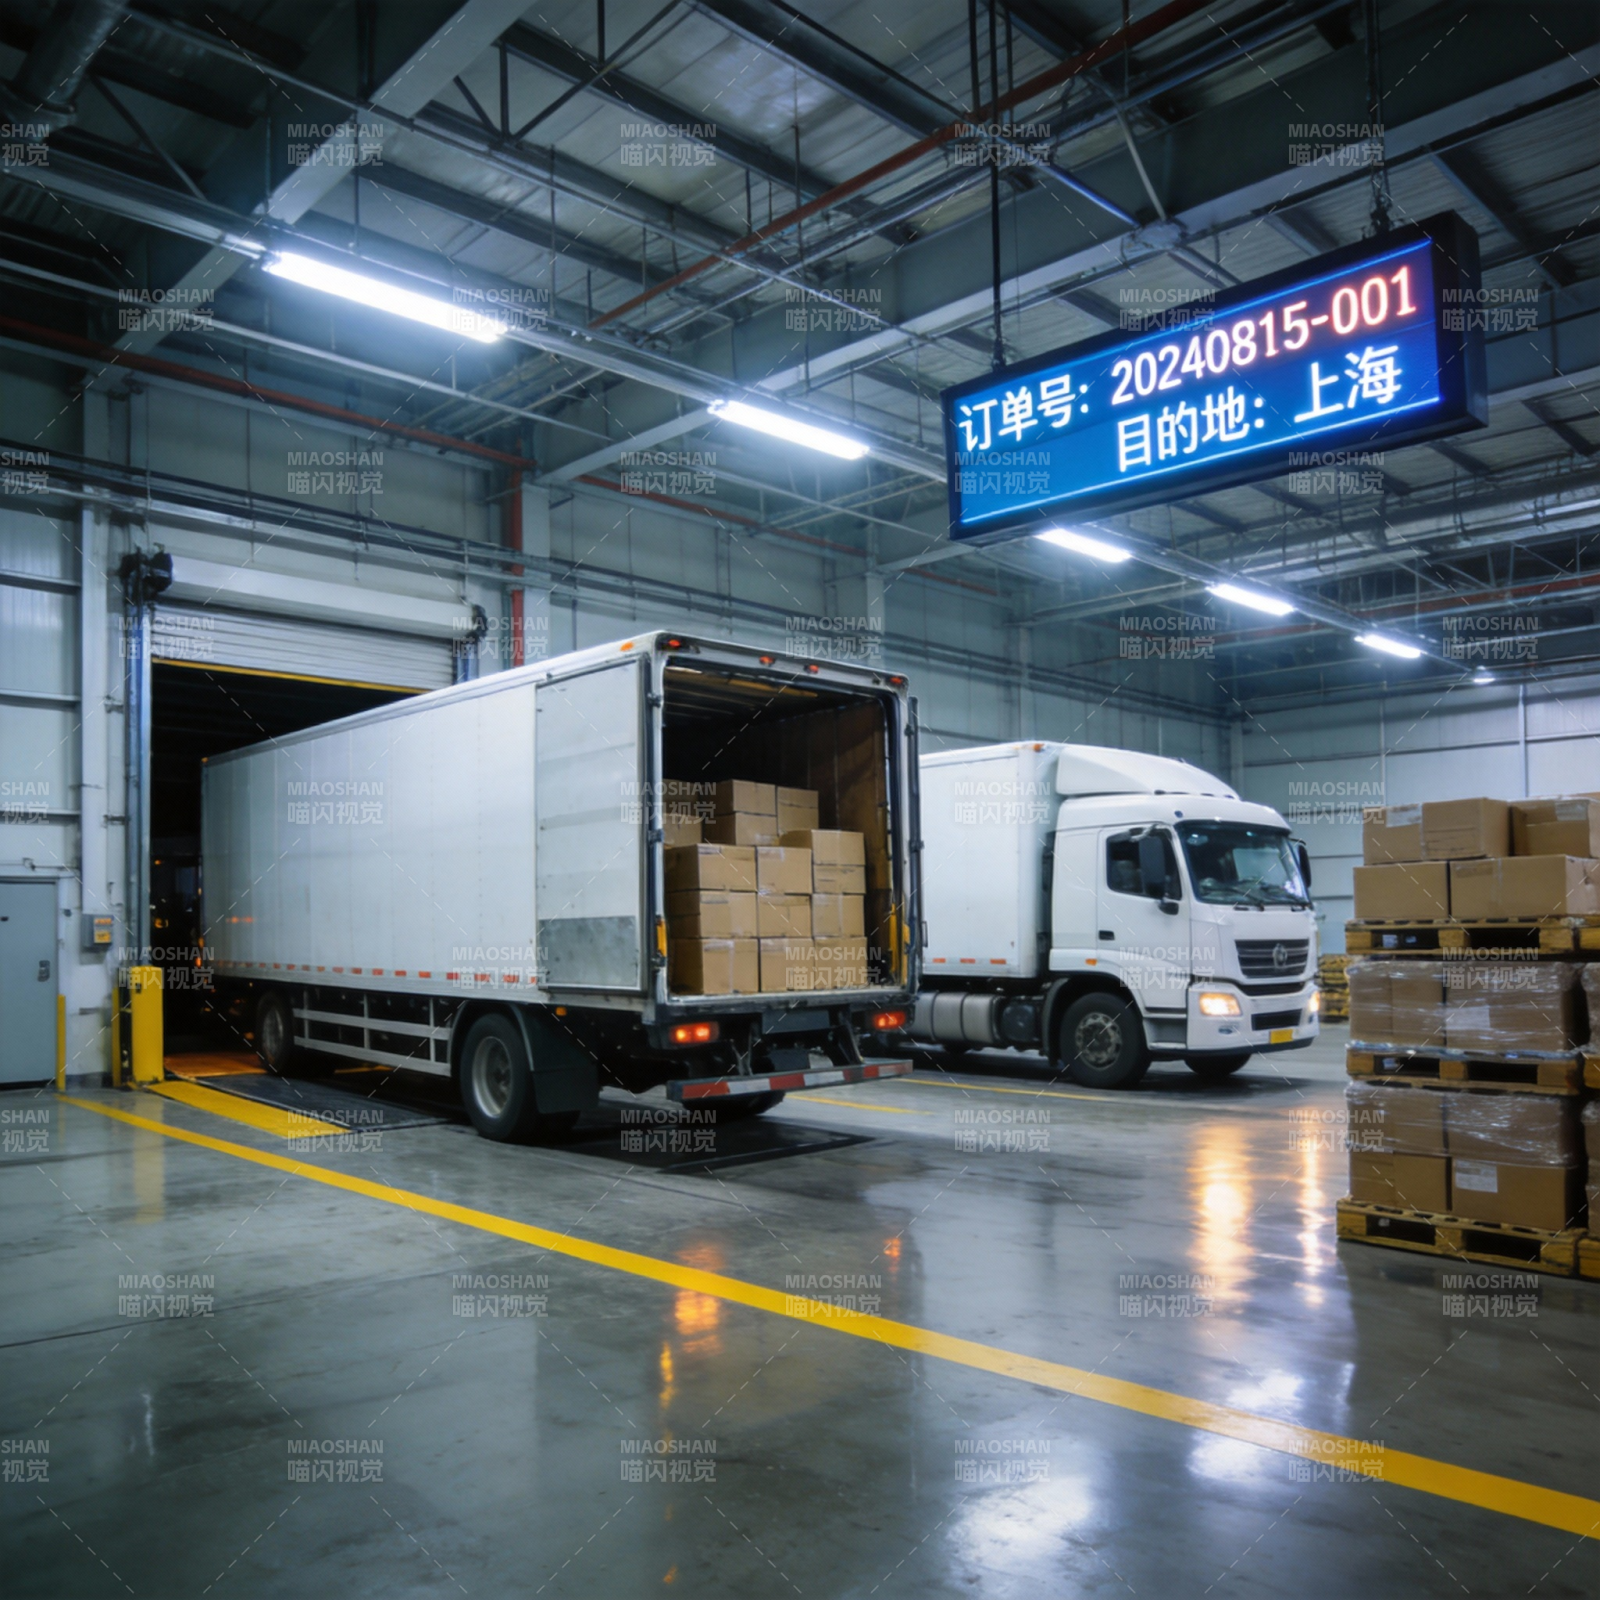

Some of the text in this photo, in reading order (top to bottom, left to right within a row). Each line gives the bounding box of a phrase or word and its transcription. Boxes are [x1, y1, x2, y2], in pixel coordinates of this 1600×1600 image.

[958, 266, 1417, 452] 订单号： 20240815-001
[1293, 344, 1403, 423] 上海
